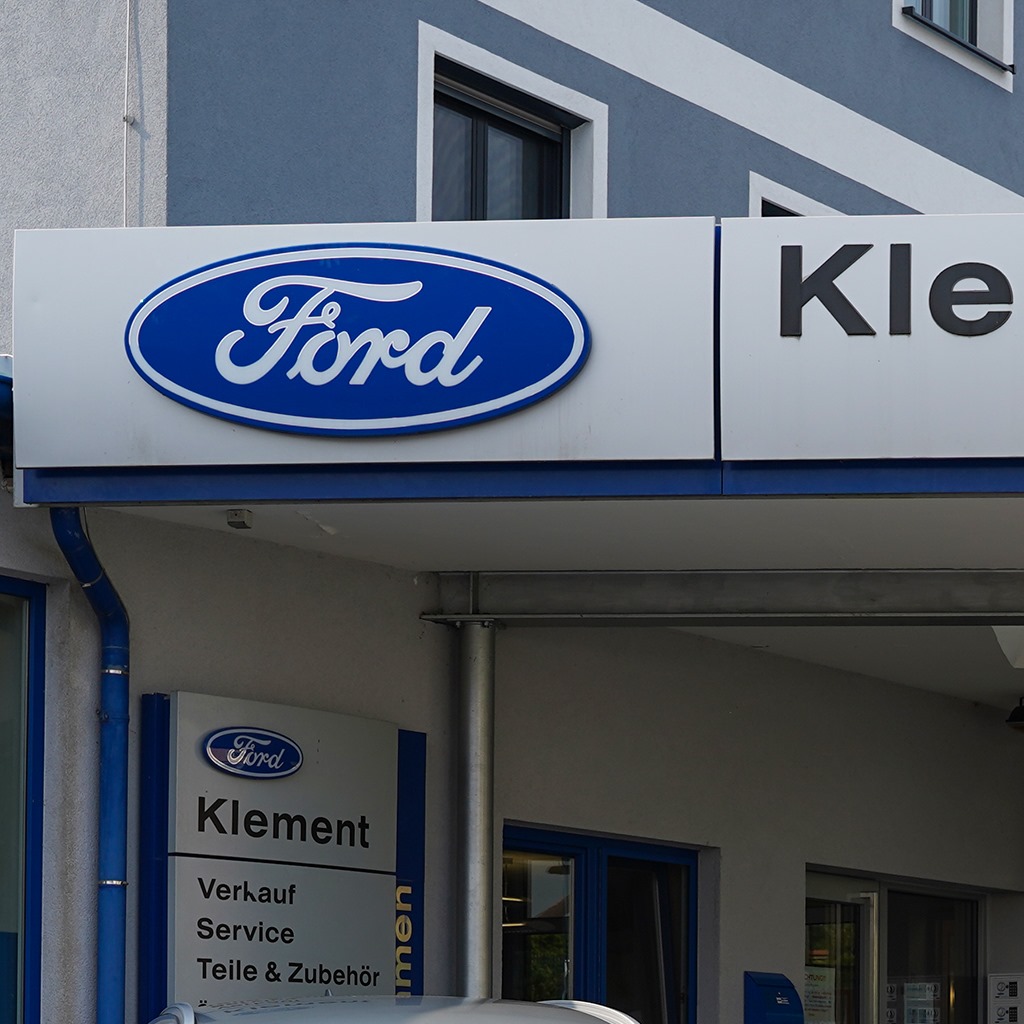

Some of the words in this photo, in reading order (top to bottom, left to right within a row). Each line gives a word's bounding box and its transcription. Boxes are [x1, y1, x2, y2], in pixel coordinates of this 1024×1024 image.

[214, 275, 493, 387] Ford
[226, 734, 286, 770] Ford
[197, 796, 370, 849] Klement
[197, 877, 296, 905] Verkauf
[196, 917, 295, 944] Service
[196, 957, 258, 982] Teile
[264, 961, 282, 983] &
[288, 962, 380, 987] Zubehör
